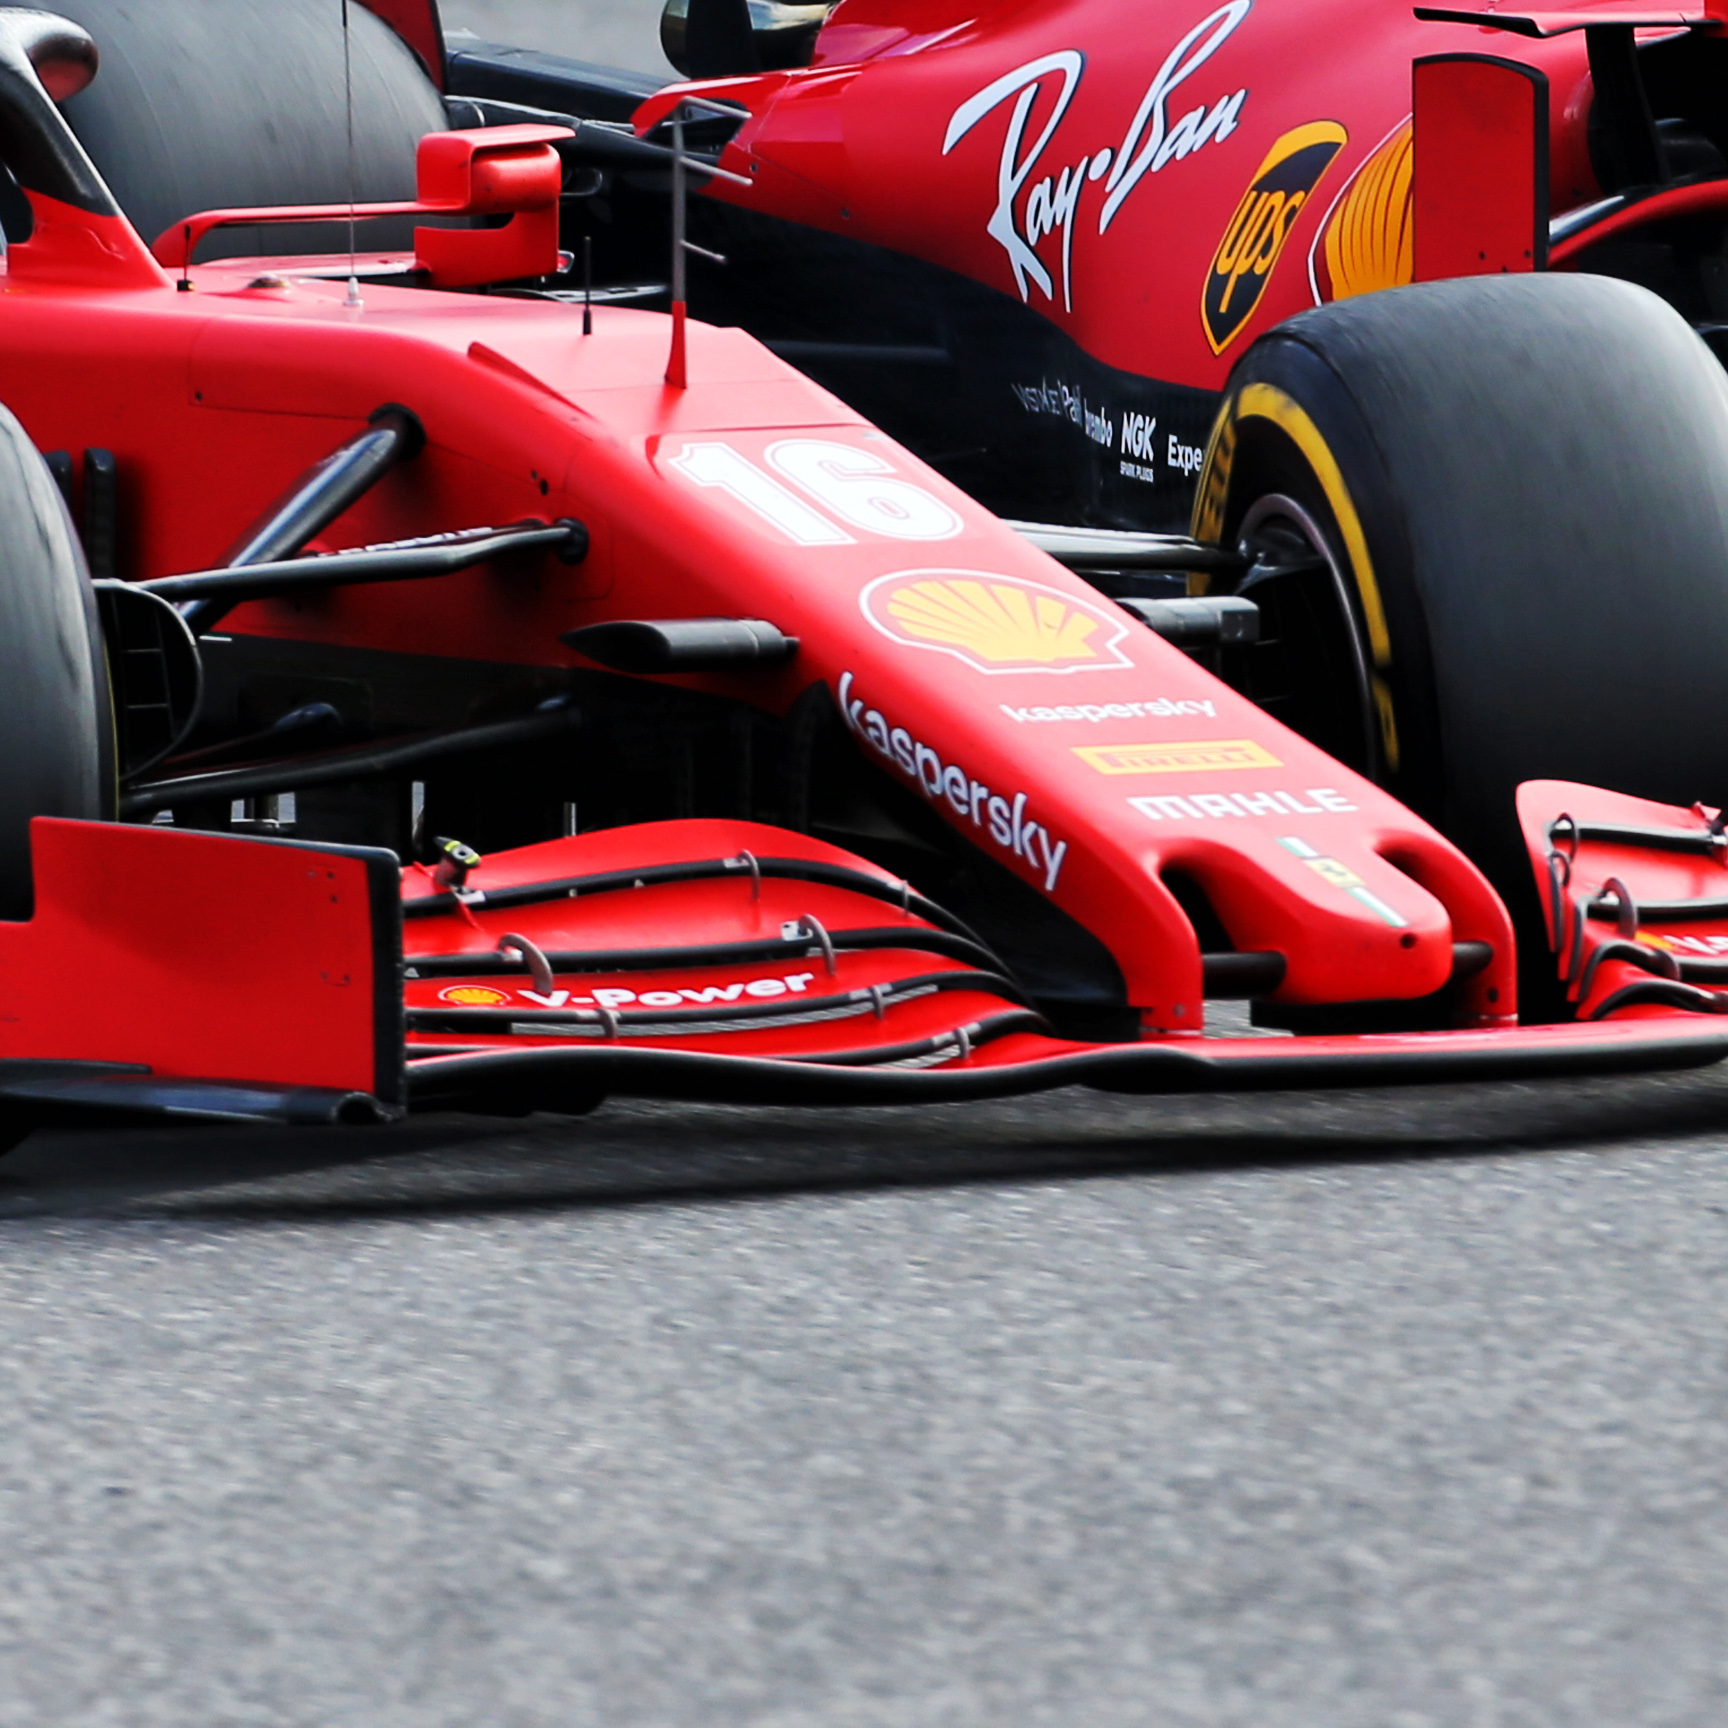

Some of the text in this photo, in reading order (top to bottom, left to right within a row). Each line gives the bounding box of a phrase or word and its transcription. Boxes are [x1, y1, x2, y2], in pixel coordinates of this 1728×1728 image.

[1216, 190, 1306, 314] ups
[1121, 411, 1157, 462] NGK
[1167, 433, 1204, 477] Expe
[668, 438, 965, 547] 16
[998, 697, 1218, 724] kaspersky
[1092, 745, 1260, 770] PIRELLI
[836, 670, 1069, 892] kaspersky
[1125, 787, 1359, 821] MAHLE
[516, 971, 814, 1008] V-Power
